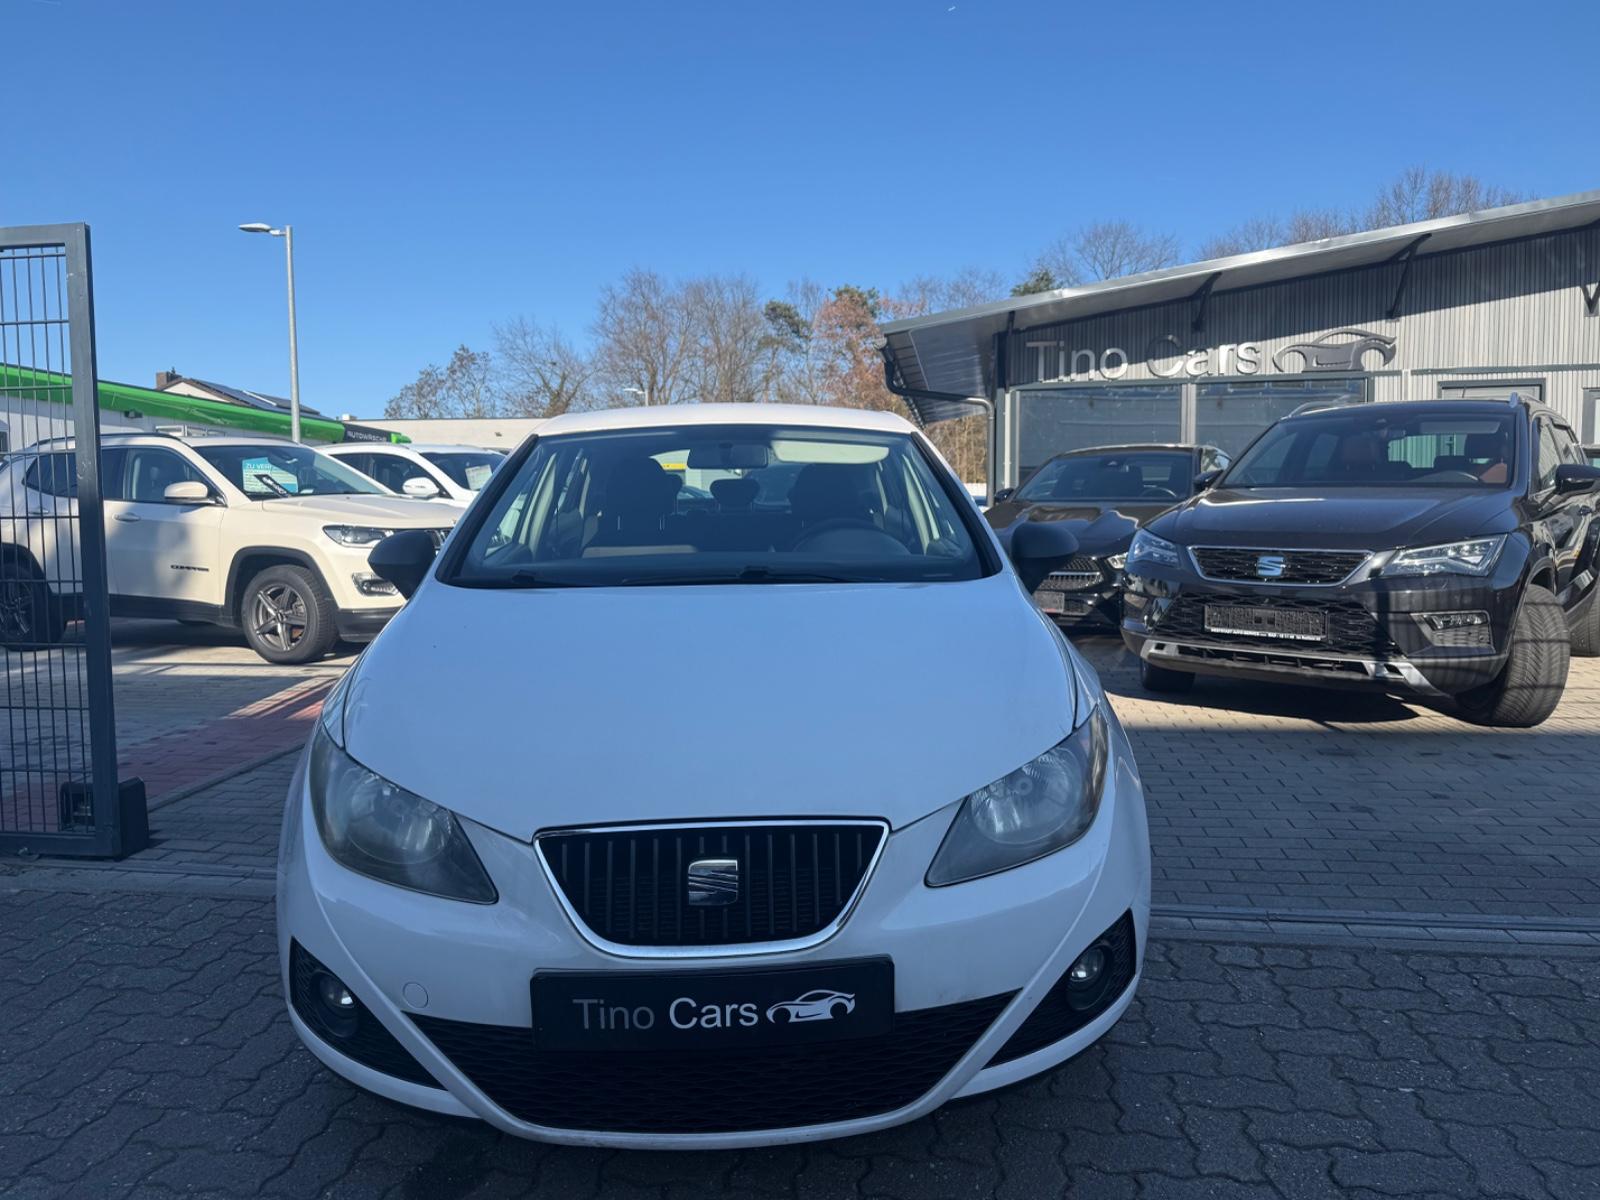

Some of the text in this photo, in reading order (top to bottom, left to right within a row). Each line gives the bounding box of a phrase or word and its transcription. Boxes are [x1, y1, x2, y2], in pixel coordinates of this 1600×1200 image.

[1026, 334, 1261, 382] Tino Cars
[572, 997, 759, 1030] Tino Cars
